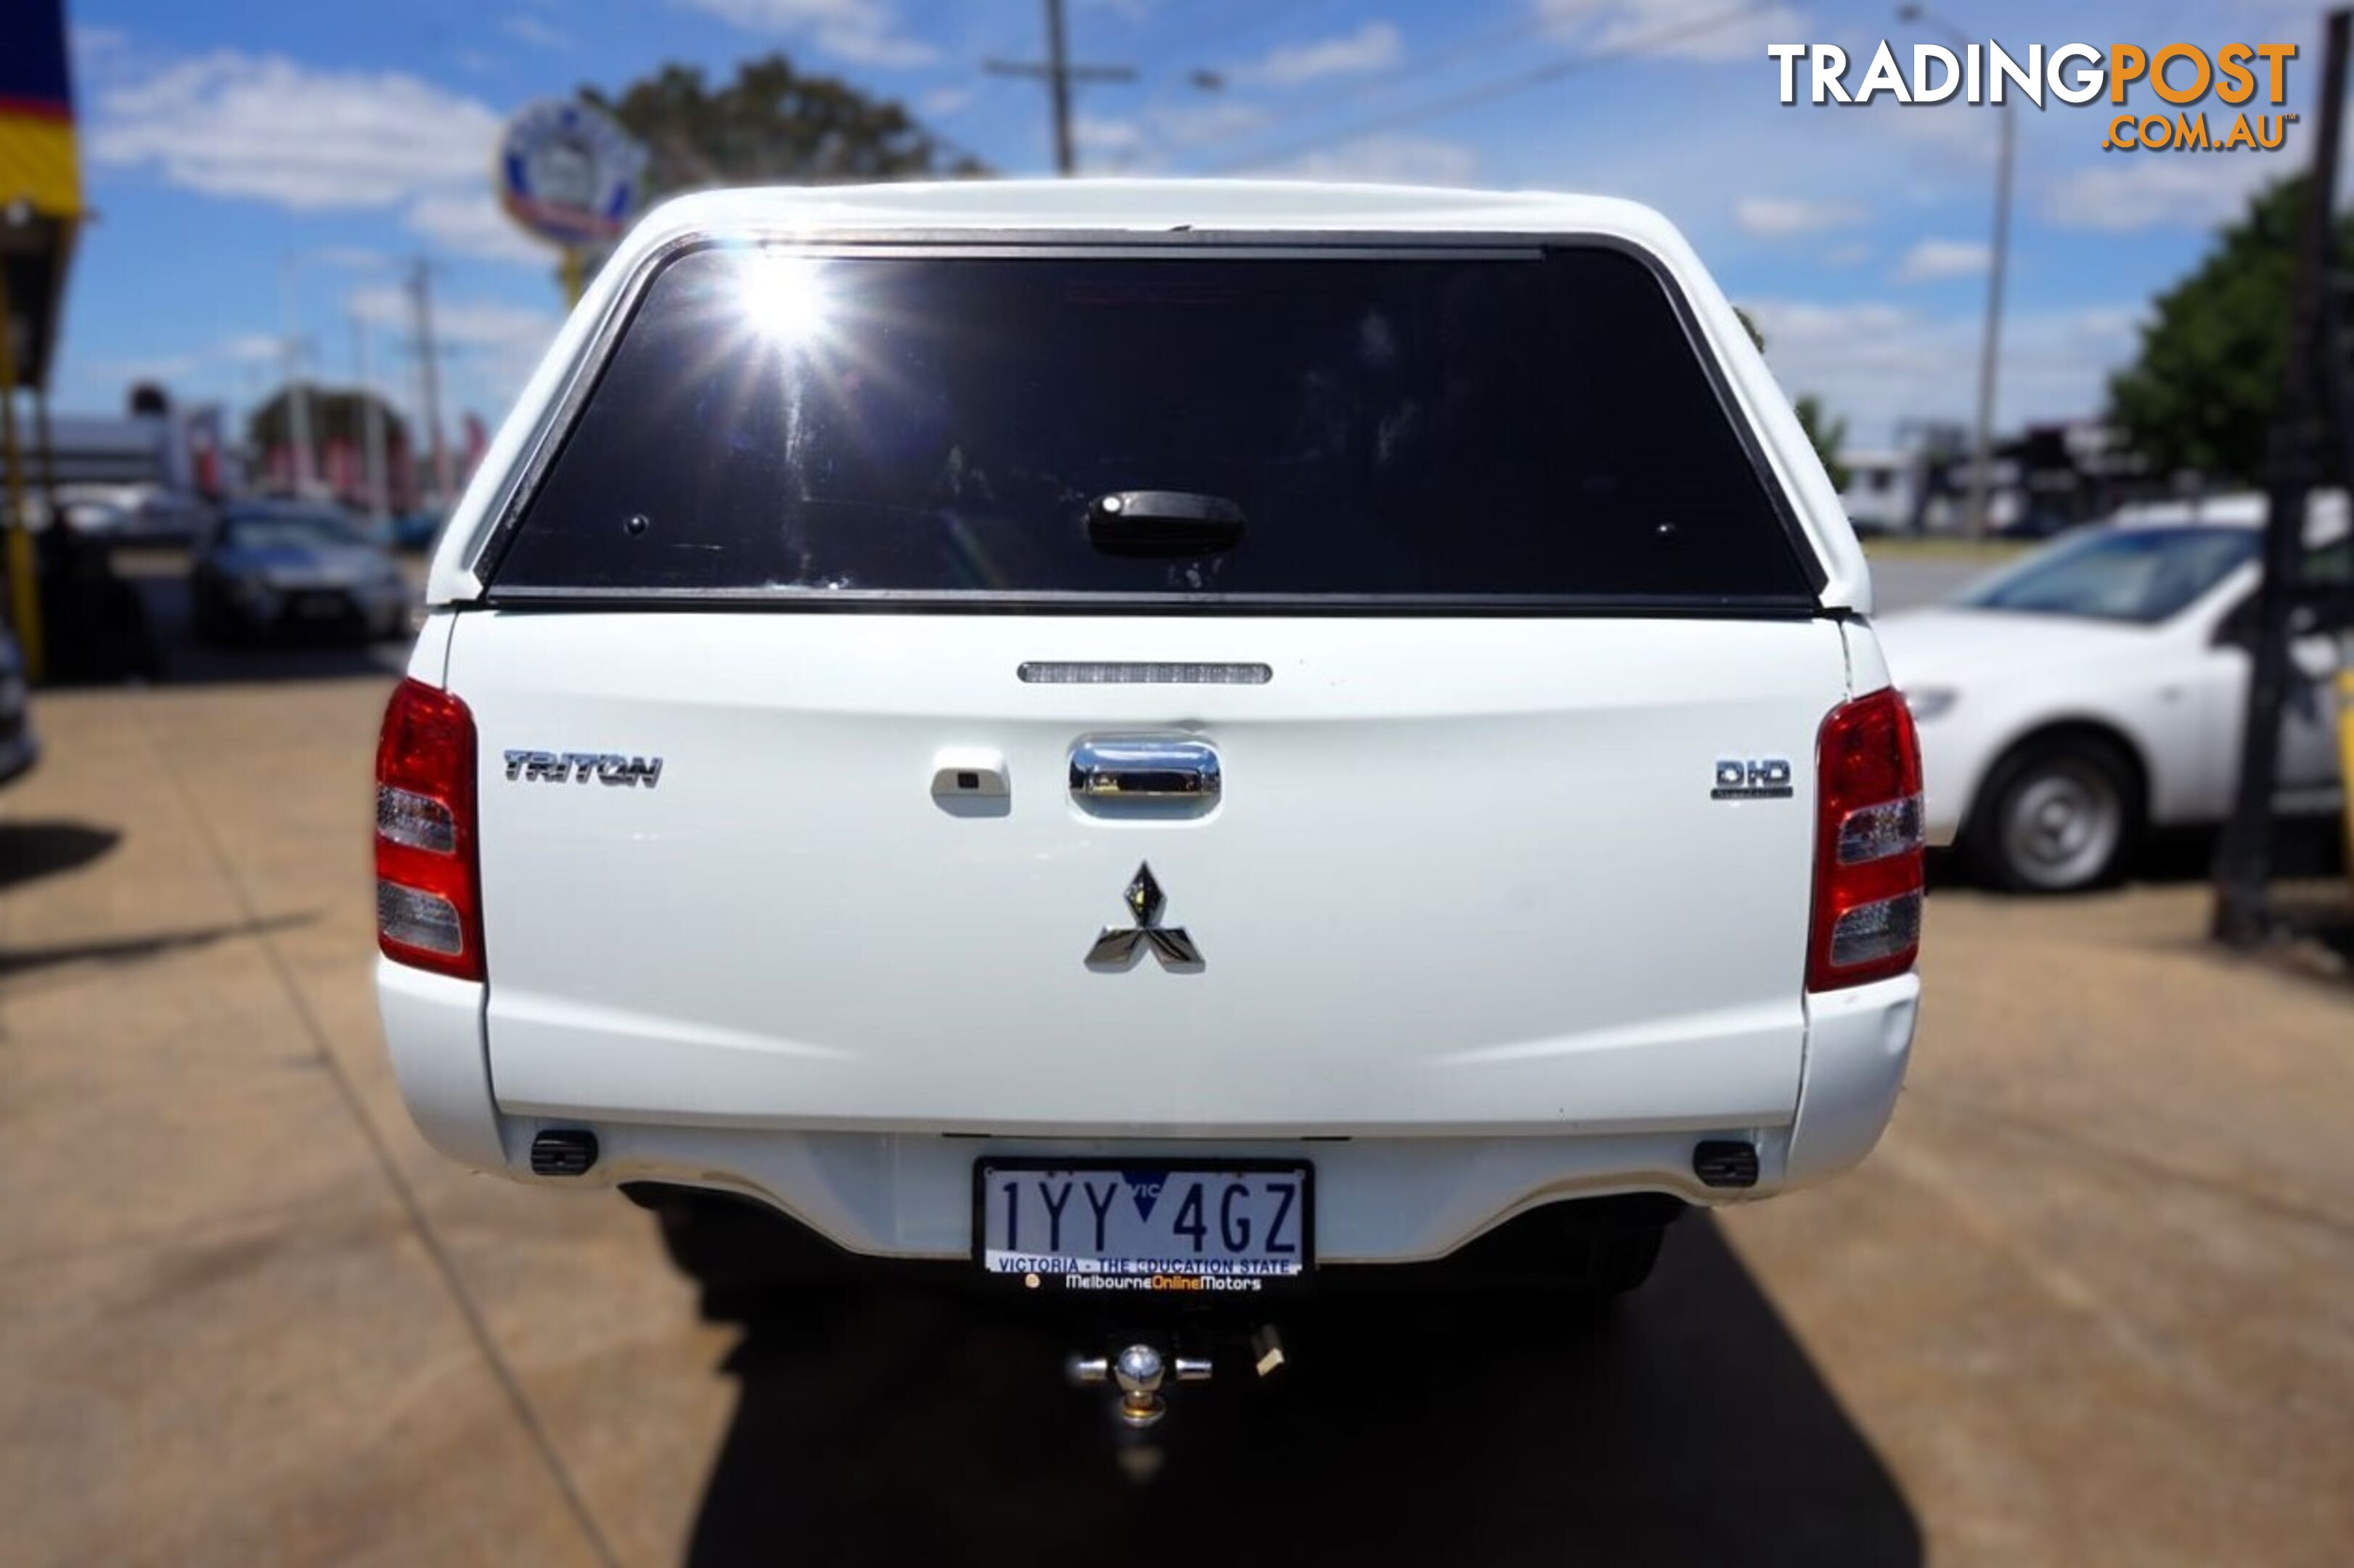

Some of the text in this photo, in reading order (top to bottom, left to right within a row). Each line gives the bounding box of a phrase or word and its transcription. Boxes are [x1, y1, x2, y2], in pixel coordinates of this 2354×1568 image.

[504, 749, 663, 788] TRITON
[1129, 1183, 1161, 1198] VIC
[1002, 1182, 1296, 1254] 1YY 4GZ
[998, 1257, 1079, 1273] VICTORIA
[1098, 1258, 1132, 1273] THE
[1136, 1258, 1234, 1274] EDUCATION
[1239, 1259, 1292, 1275] STATE
[1065, 1274, 1262, 1291] MelbourneOnlineMotors
